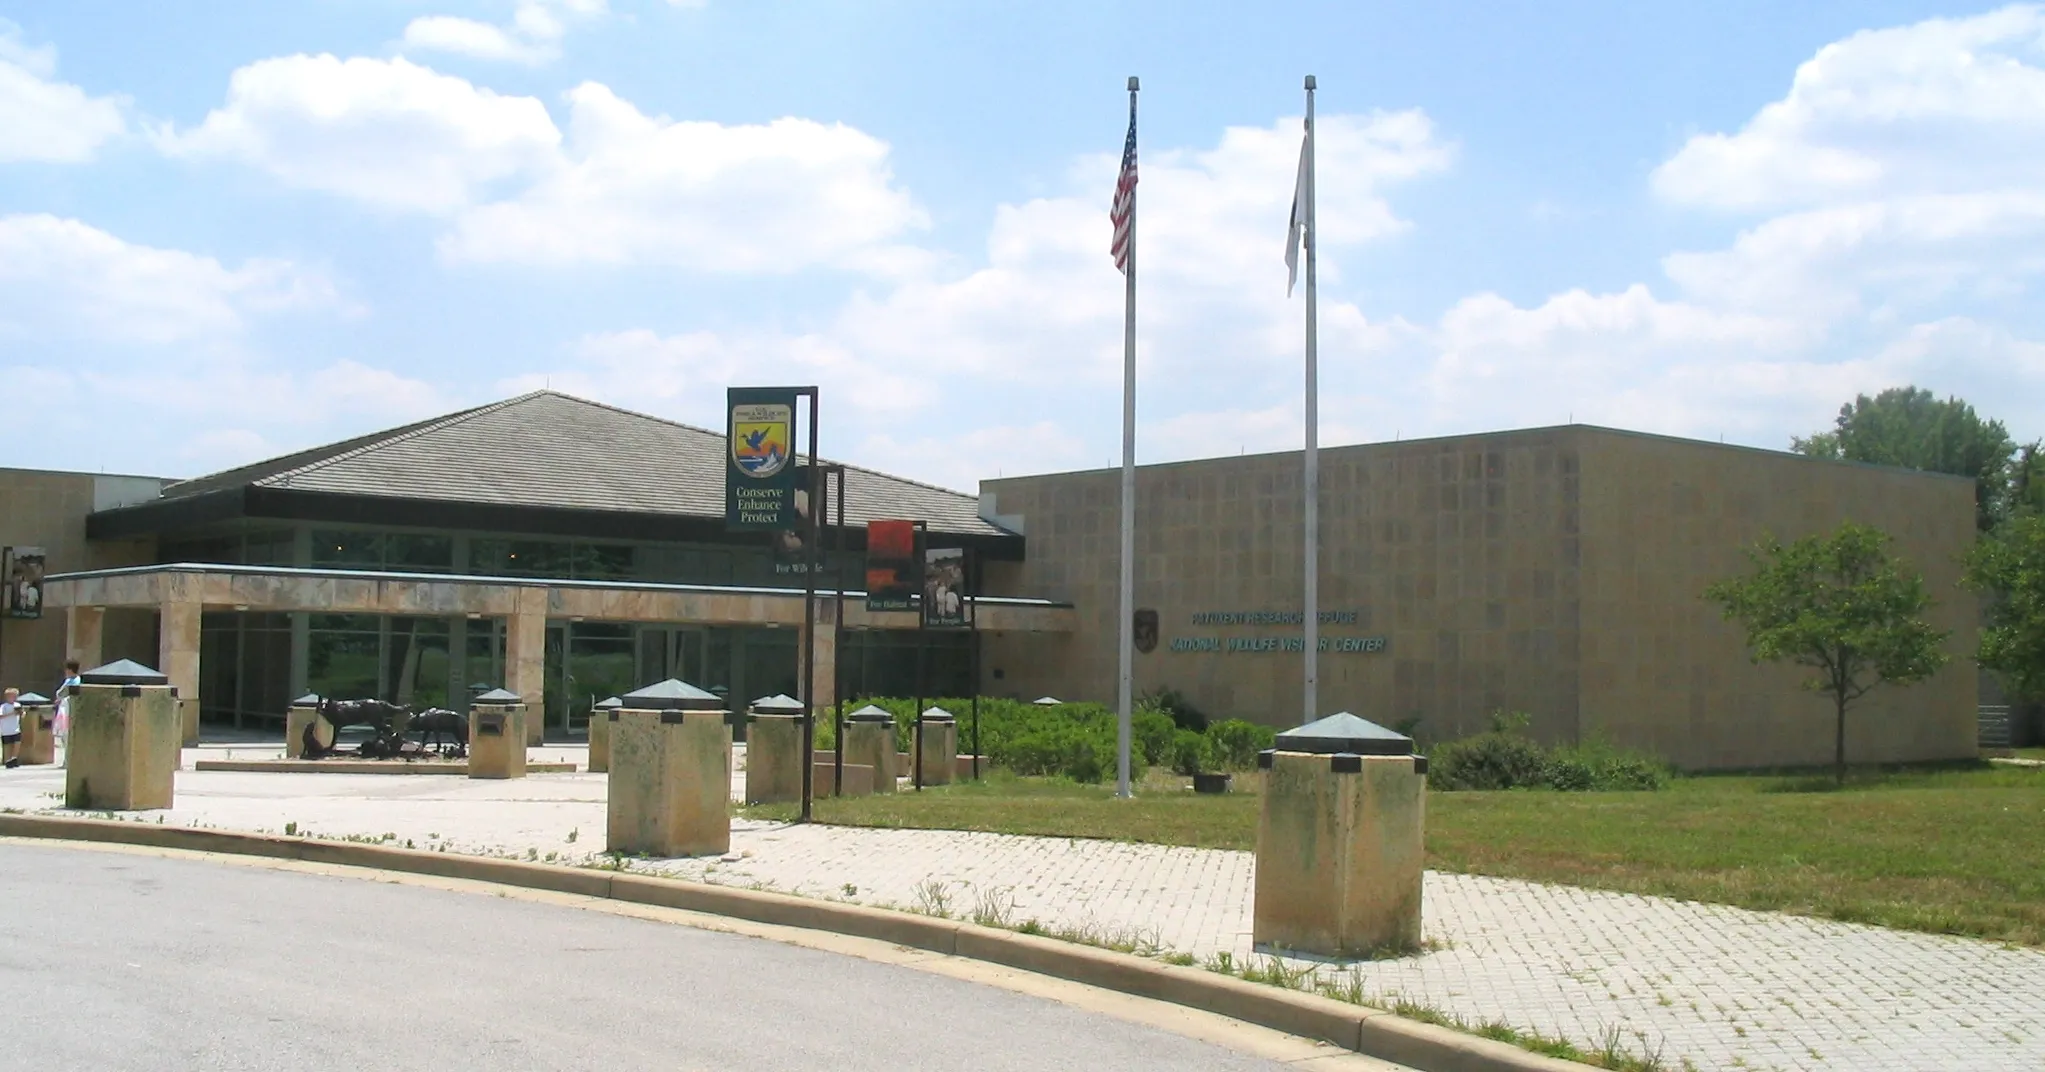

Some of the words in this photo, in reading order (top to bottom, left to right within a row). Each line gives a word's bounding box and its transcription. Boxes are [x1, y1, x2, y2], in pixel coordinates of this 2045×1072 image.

[736, 486, 783, 498] Conserve
[738, 499, 781, 510] Enhance
[741, 511, 778, 523] Protect
[1170, 637, 1221, 652] NATIONAL
[1226, 637, 1278, 653] WILDLIFE
[1333, 637, 1386, 652] CENTER
